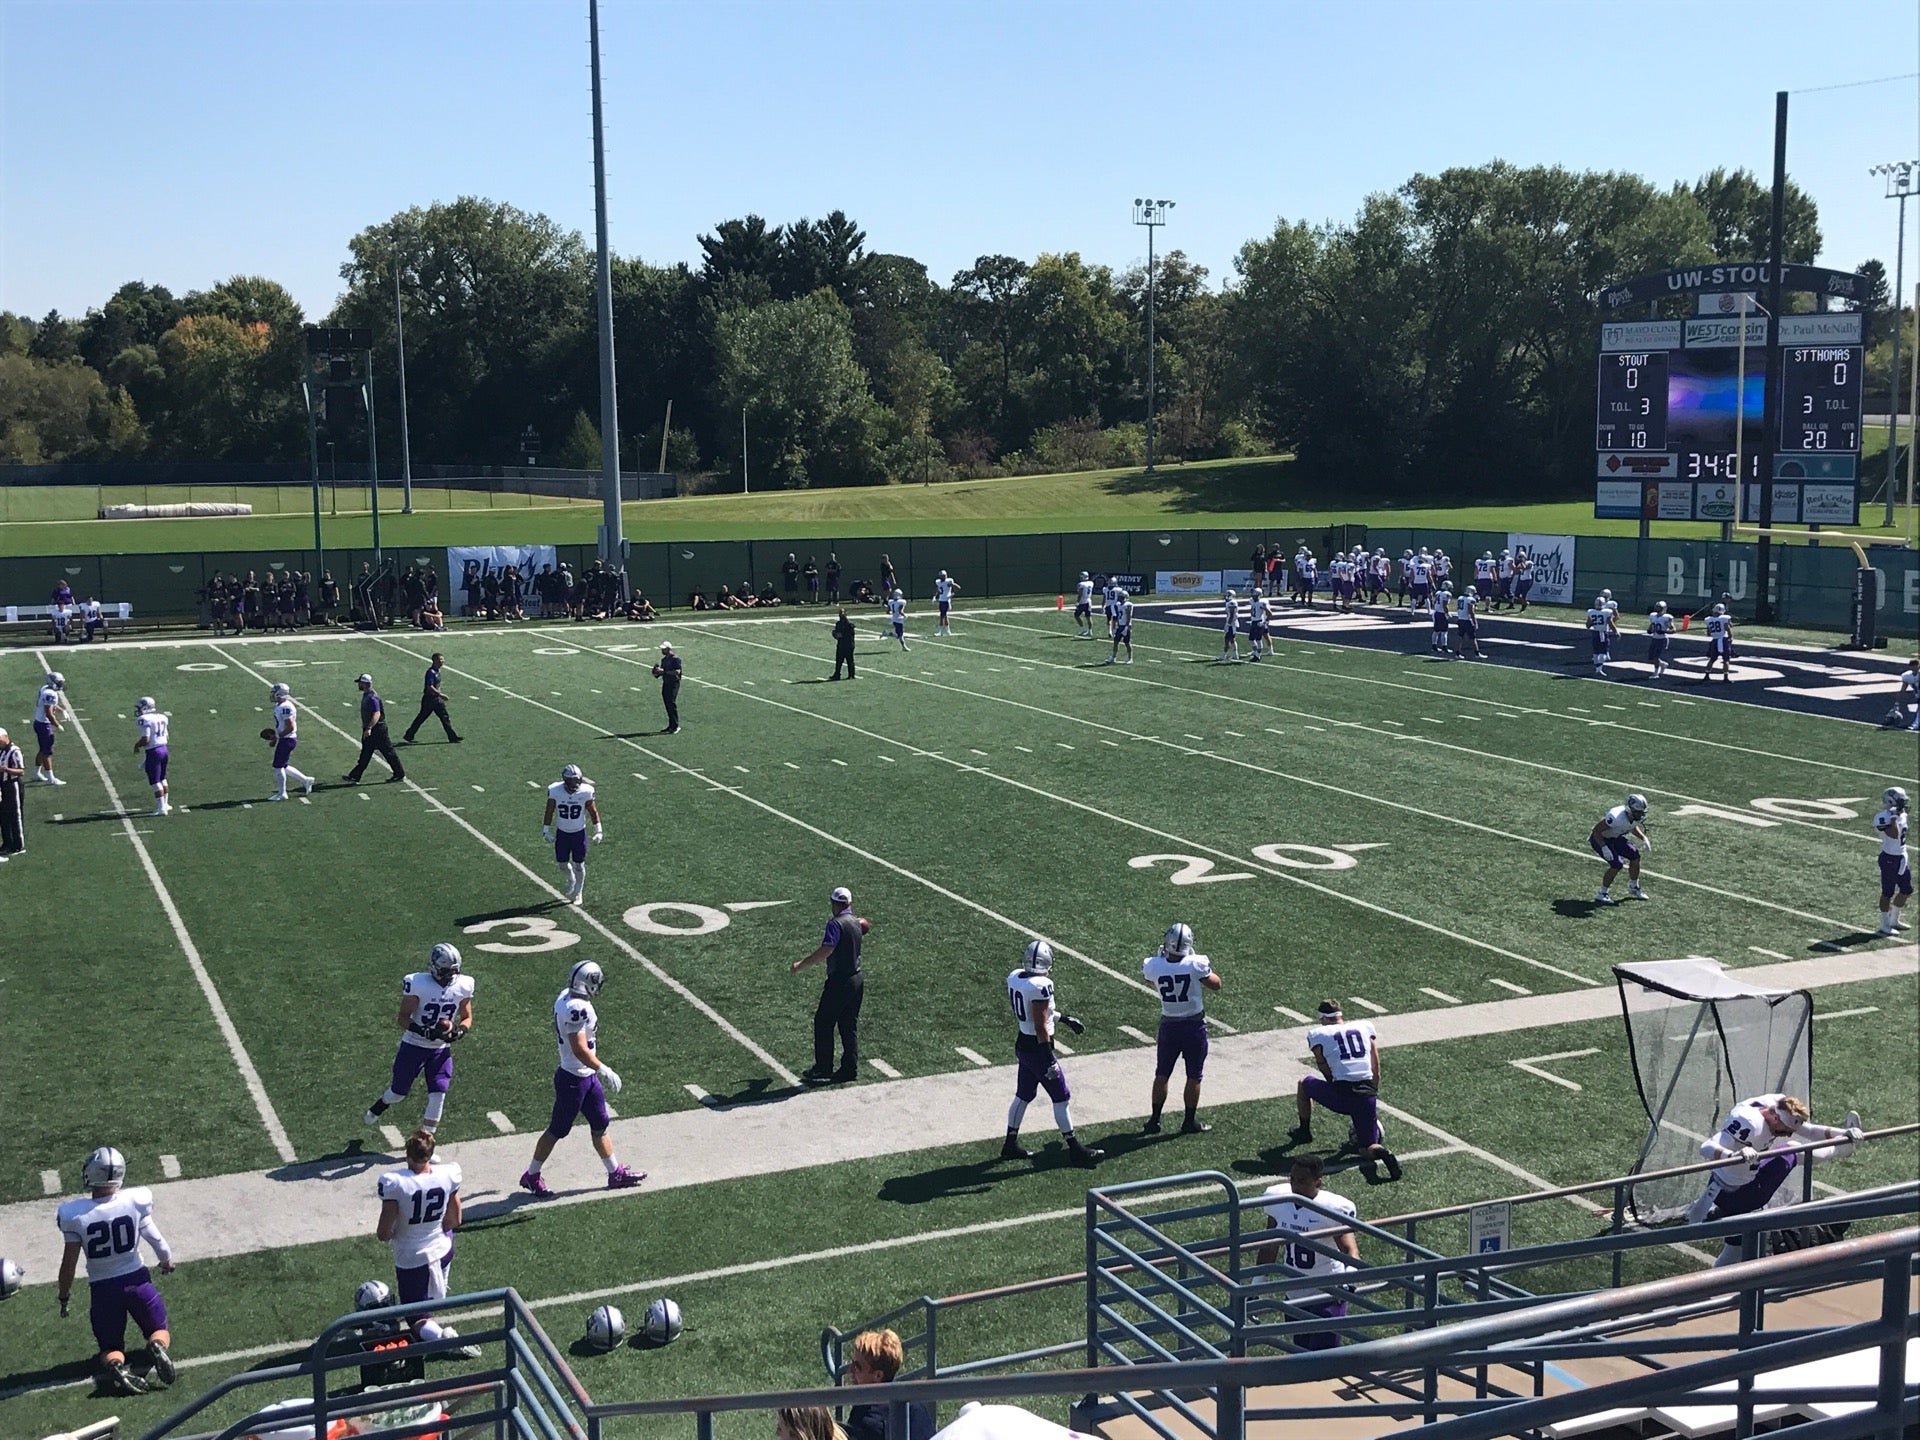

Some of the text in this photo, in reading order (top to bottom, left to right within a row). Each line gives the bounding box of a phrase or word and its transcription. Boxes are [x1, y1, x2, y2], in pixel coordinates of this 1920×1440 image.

[1667, 266, 1790, 290] UW-STOUT
[1793, 325, 1814, 335] Paul
[1817, 323, 1859, 336] McNally
[1618, 354, 1649, 366] STOUT
[1794, 349, 1850, 362] ST THOMAS
[1626, 368, 1638, 389] 0
[1833, 363, 1847, 385] 0
[1610, 402, 1632, 412] T.O.L.
[1641, 397, 1650, 415] 3
[1803, 395, 1813, 414] 3
[1825, 399, 1850, 410] T.O.L.
[1607, 432, 1611, 447] 1
[1631, 431, 1647, 448] 10
[1803, 431, 1827, 449] 20
[1850, 432, 1854, 448] 1
[1531, 562, 1569, 586] evils
[1106, 590, 1116, 600] 19
[1591, 614, 1605, 626] 23
[1708, 621, 1722, 633] 28
[1669, 797, 1860, 828] 10
[1127, 843, 1358, 886] 20
[463, 902, 731, 954] 30
[1157, 974, 1191, 1003] 27
[420, 1003, 457, 1027] 33
[1333, 1029, 1366, 1060] 10
[1726, 1119, 1751, 1142] 24
[408, 1187, 446, 1225] 12
[86, 1215, 135, 1259] 20
